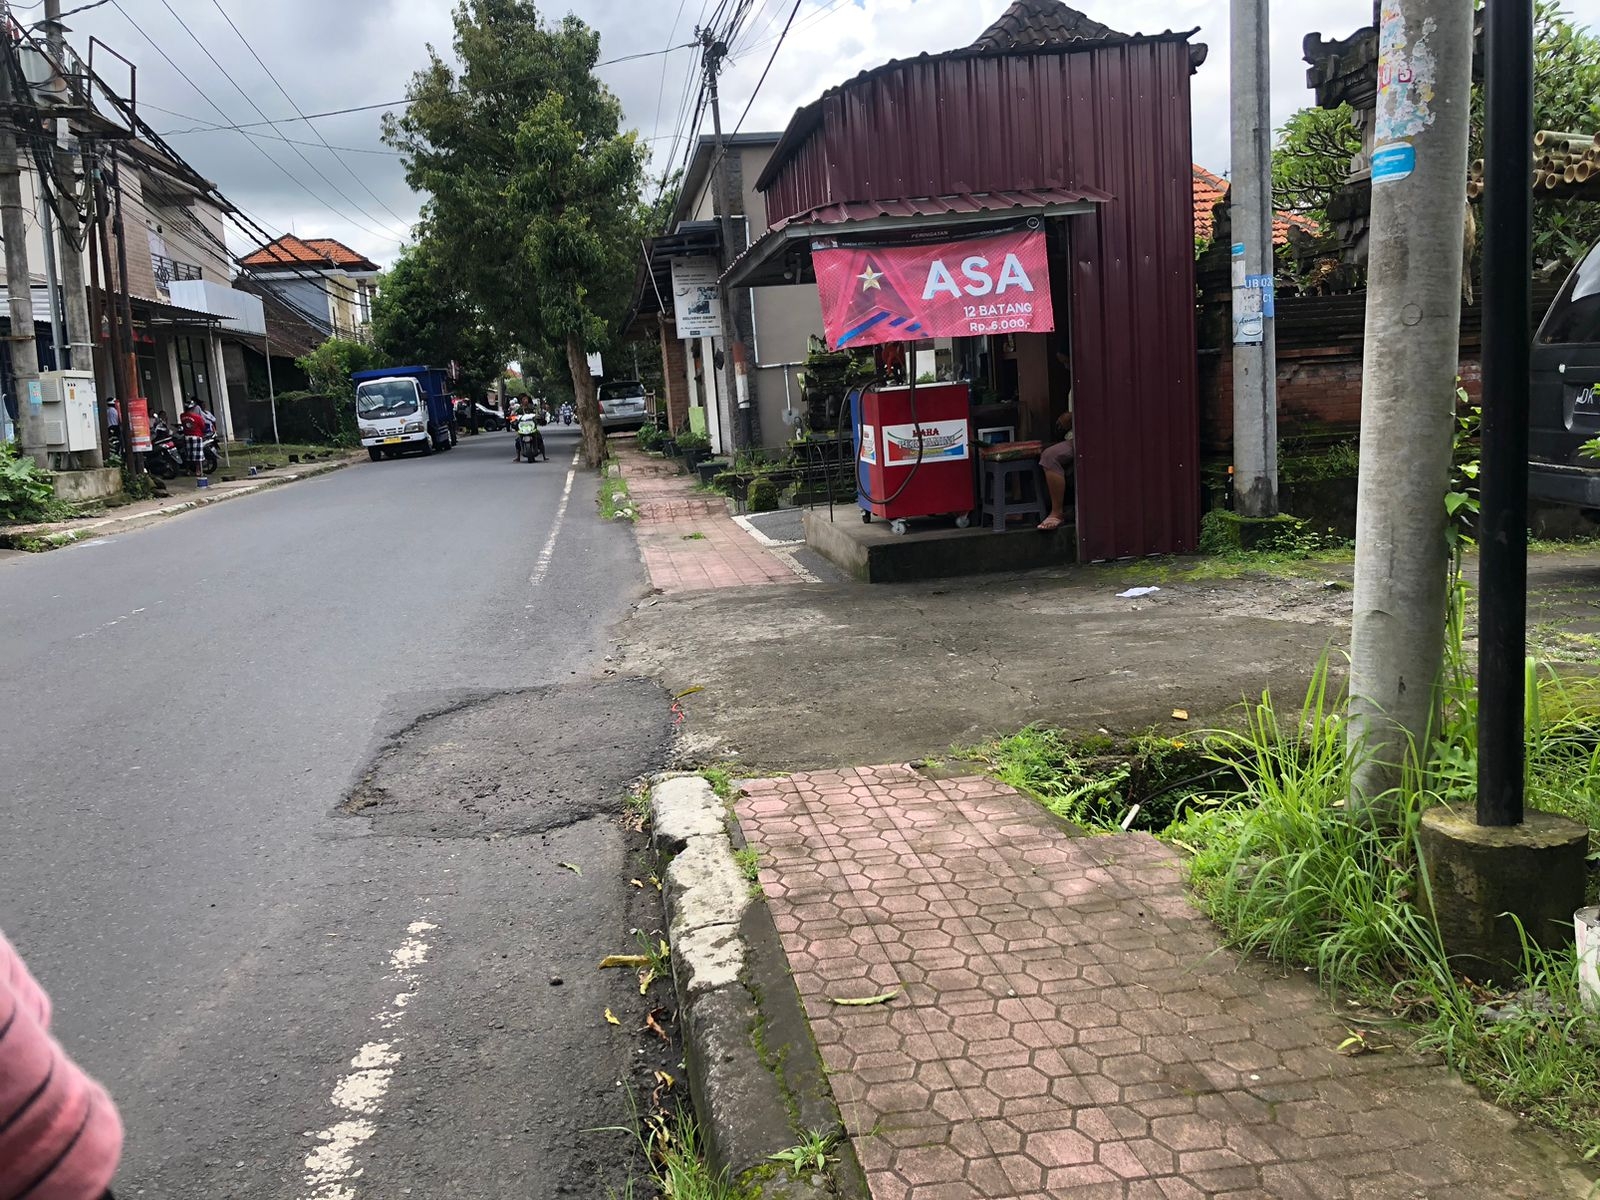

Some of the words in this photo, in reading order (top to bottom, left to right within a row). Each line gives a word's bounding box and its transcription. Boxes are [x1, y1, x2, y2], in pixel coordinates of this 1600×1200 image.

[921, 253, 1034, 300] ASA
[963, 305, 976, 318] 12
[979, 302, 1033, 316] BATANG
